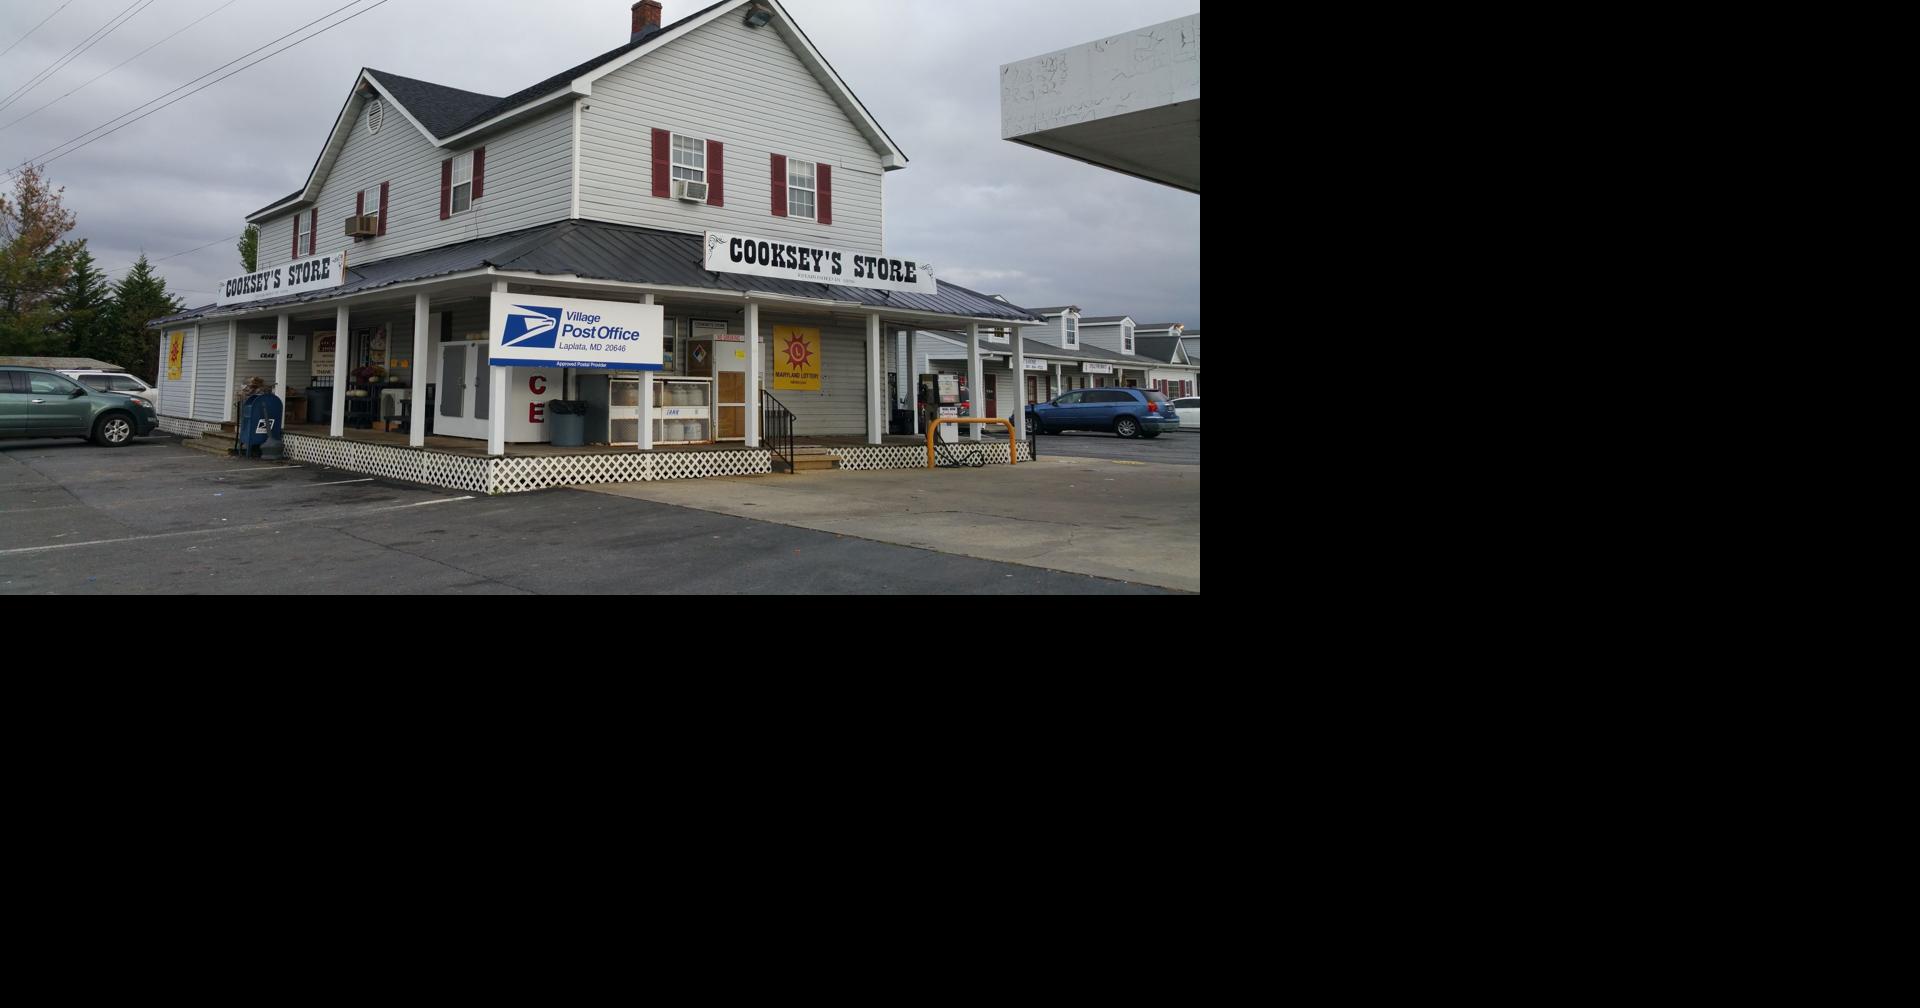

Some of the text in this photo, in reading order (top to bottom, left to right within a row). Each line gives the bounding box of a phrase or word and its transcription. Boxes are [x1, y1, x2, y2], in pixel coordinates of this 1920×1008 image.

[730, 237, 917, 284] COOKSEY'S STORE
[226, 257, 331, 297] COOKSEY'S STORE
[566, 311, 601, 324] Village
[561, 324, 640, 341] Post Office
[559, 342, 626, 352] Laplata, MD 20646
